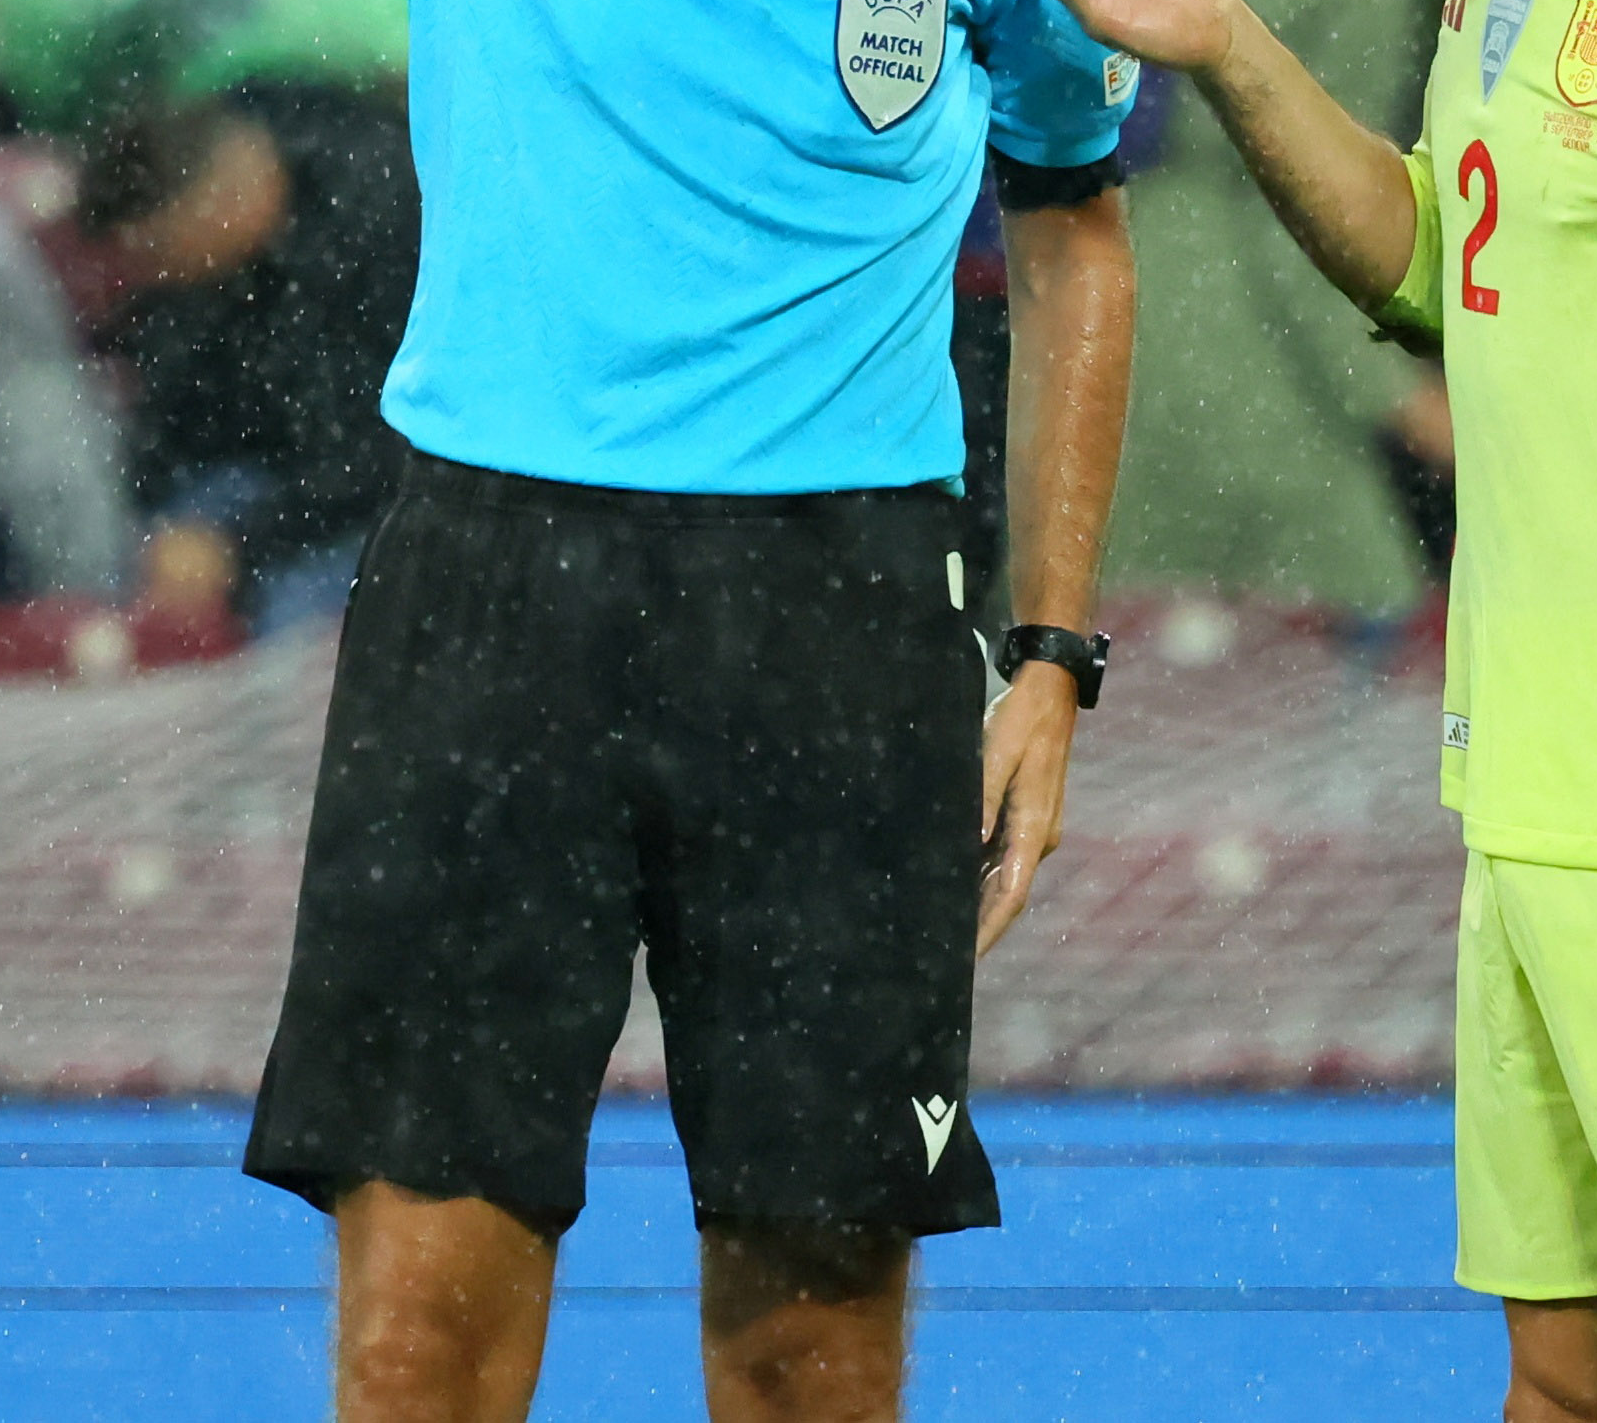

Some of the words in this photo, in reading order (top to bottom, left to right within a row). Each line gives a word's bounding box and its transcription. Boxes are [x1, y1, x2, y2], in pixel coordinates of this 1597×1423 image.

[860, 31, 923, 57] MATCH
[849, 55, 925, 83] OFFICIAL
[1458, 139, 1500, 316] 2
